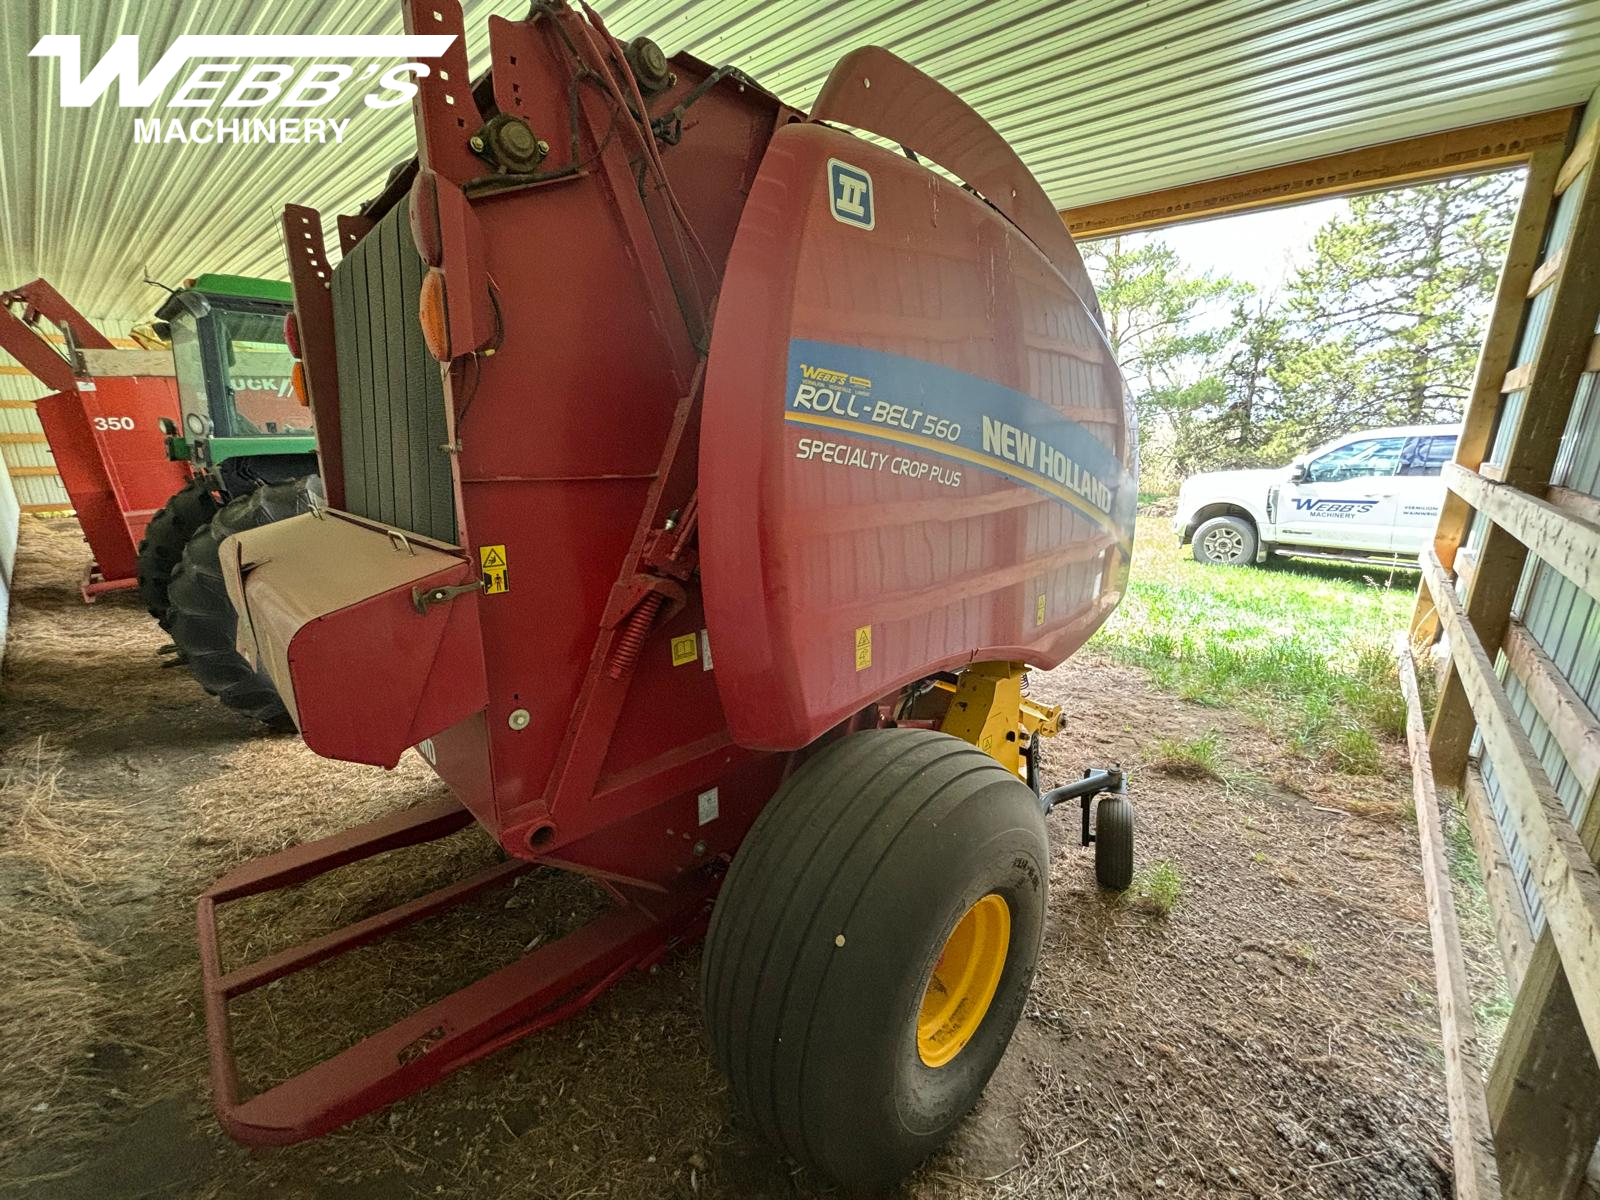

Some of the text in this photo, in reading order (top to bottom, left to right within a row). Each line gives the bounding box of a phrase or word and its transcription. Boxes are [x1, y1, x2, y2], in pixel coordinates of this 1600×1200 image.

[229, 377, 279, 392] UCK
[799, 364, 848, 386] WEBB'S
[93, 416, 135, 431] 350
[921, 414, 962, 442] 560
[796, 438, 962, 488] SPECIALTY CROP PLUS
[982, 415, 1112, 514] NEW HOLLAND
[1290, 498, 1380, 514] WEBB'S
[1309, 511, 1356, 520] MACHINERY
